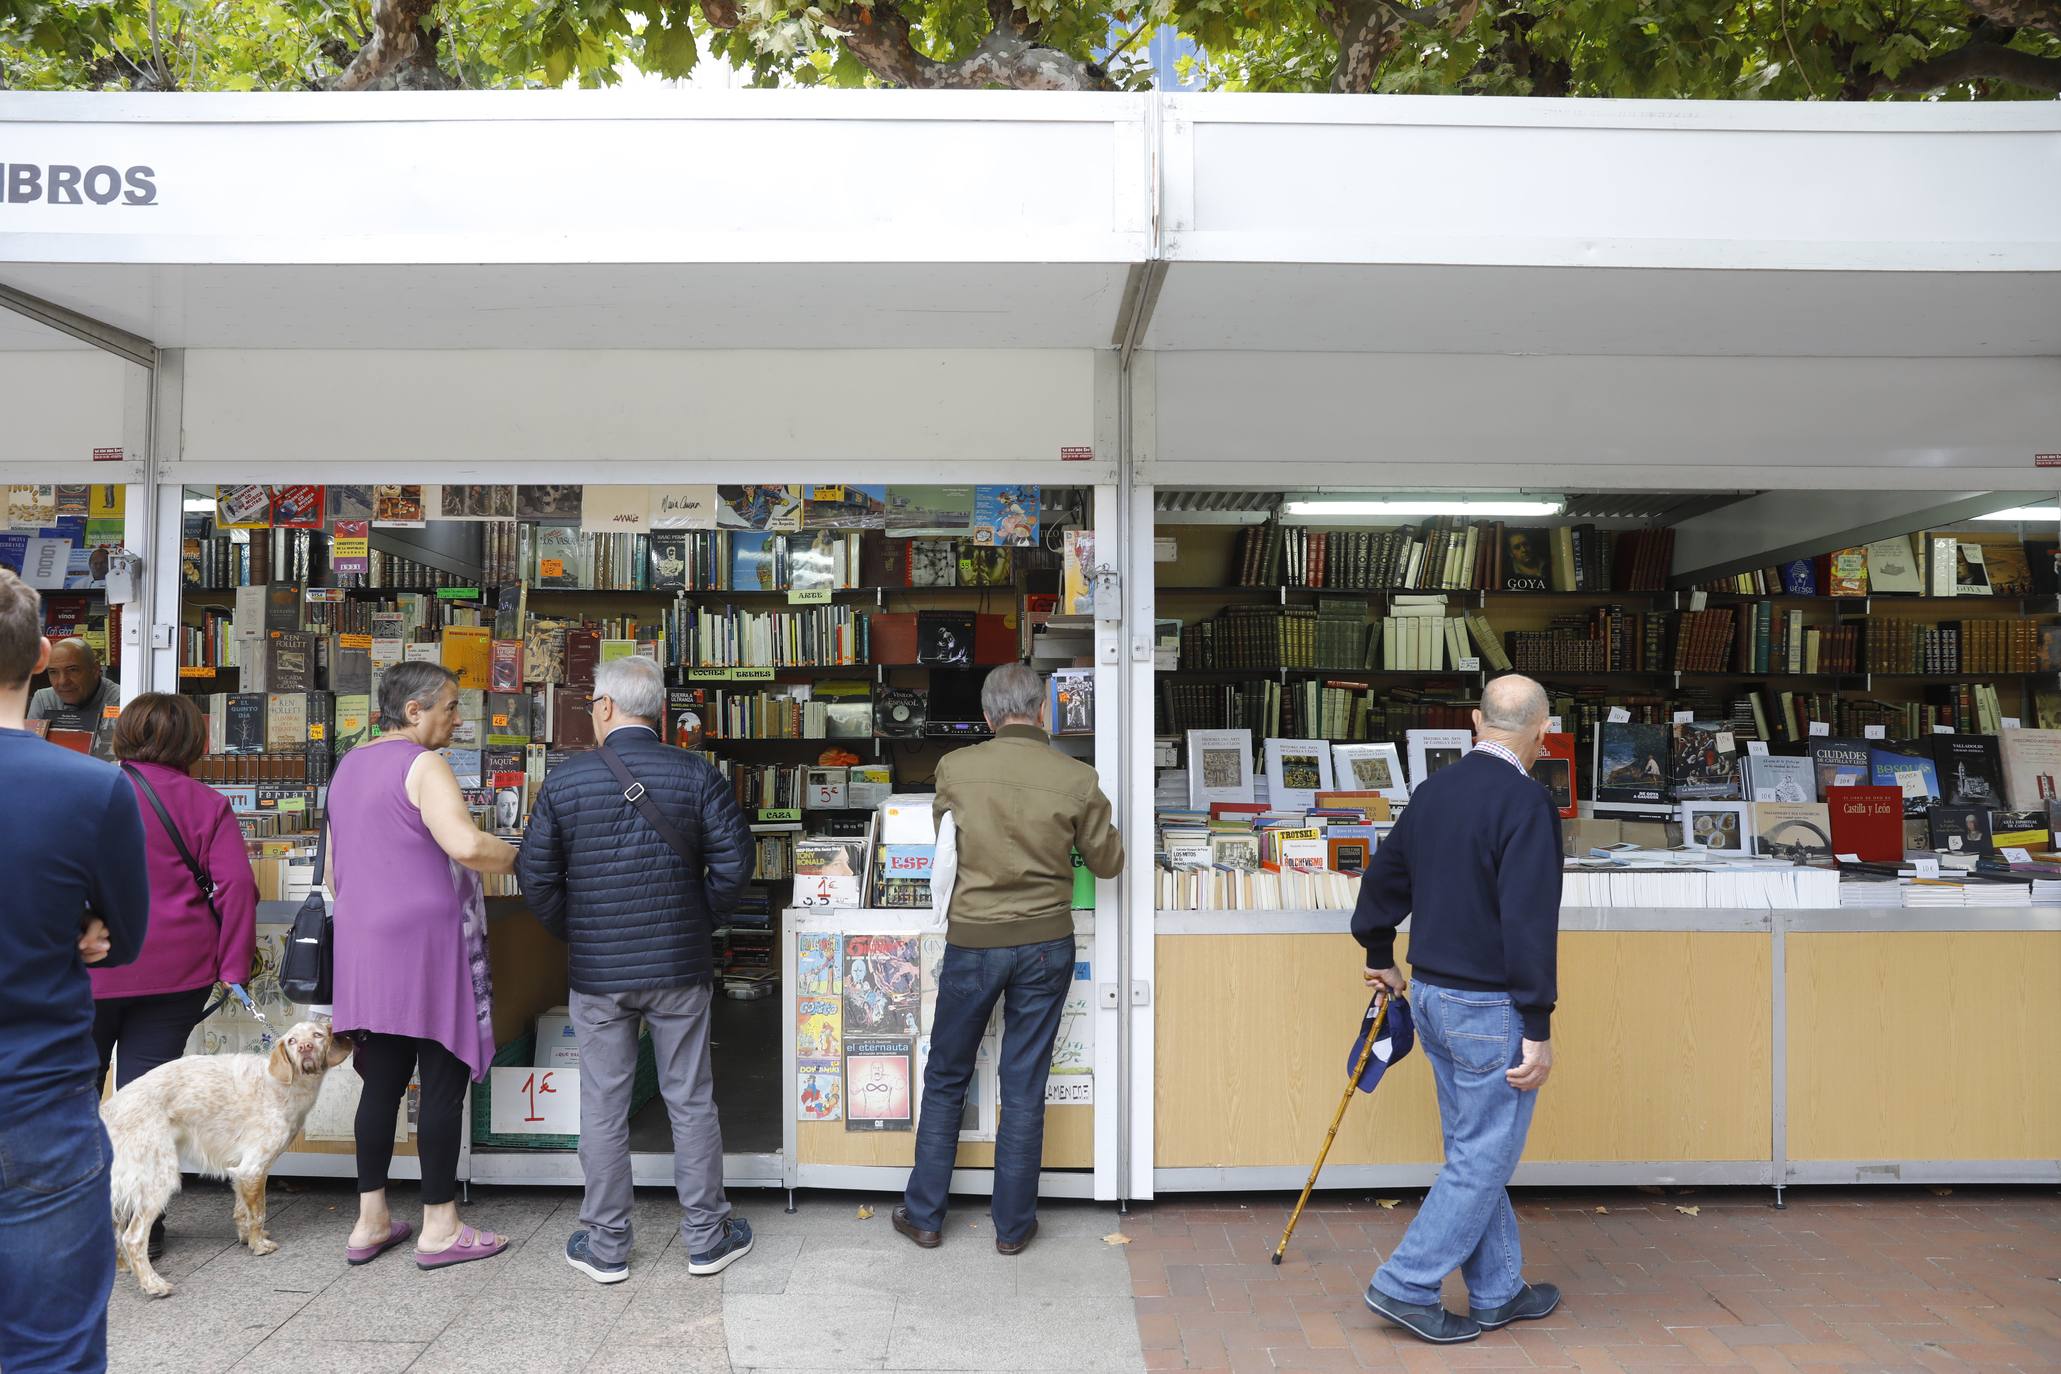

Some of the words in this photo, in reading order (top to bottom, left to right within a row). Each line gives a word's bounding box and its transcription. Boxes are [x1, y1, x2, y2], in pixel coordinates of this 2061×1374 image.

[1508, 578, 1546, 592] GOYA
[1816, 749, 1867, 760] CIUDADES
[821, 787, 838, 803] 5€
[1843, 803, 1866, 813] Castilla
[1868, 806, 1872, 816] y
[1874, 803, 1890, 813] León
[521, 1072, 557, 1121] 1€
